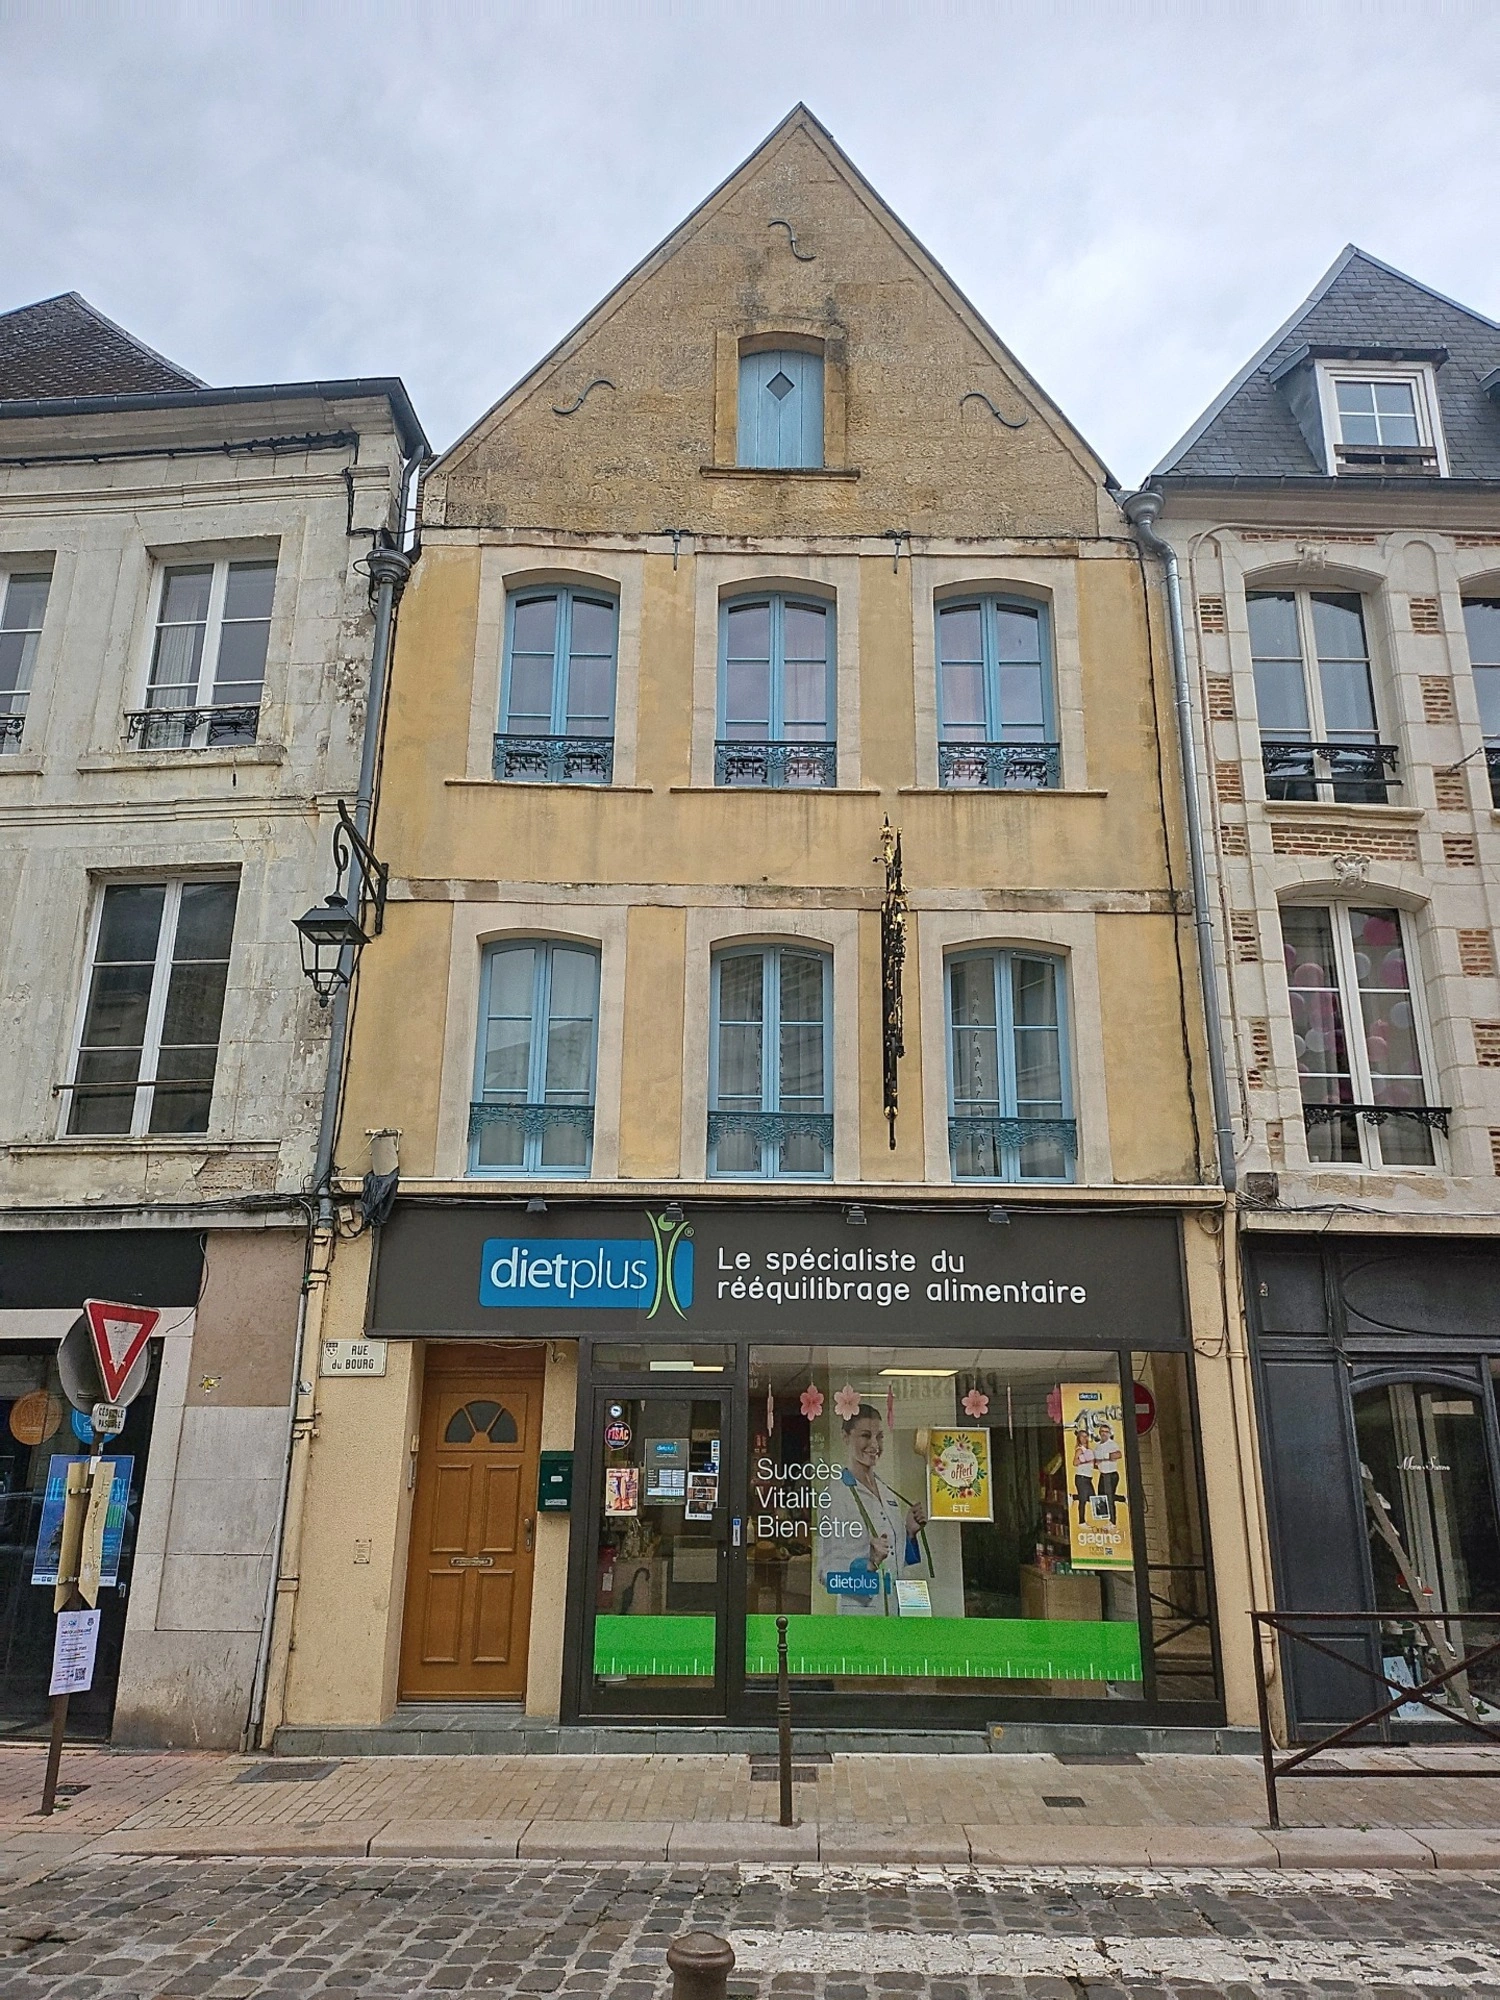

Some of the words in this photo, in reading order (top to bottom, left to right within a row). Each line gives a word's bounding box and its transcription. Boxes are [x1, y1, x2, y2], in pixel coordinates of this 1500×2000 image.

[491, 1247, 648, 1299] dietplus
[718, 1248, 750, 1270] Le
[766, 1248, 916, 1275] spécialiste
[931, 1250, 965, 1273] du
[717, 1276, 911, 1306] rééquilibrage
[926, 1279, 1087, 1304] alimentaire
[351, 1345, 369, 1356] RUE
[331, 1359, 342, 1370] du
[345, 1358, 374, 1370] BOURG
[757, 1457, 842, 1480] Succès
[756, 1486, 832, 1509] Vitalité
[952, 1503, 970, 1513] ÉTÉ
[757, 1515, 863, 1538] Bien-être
[1078, 1531, 1122, 1547] gagné
[829, 1574, 878, 1592] dietplus
